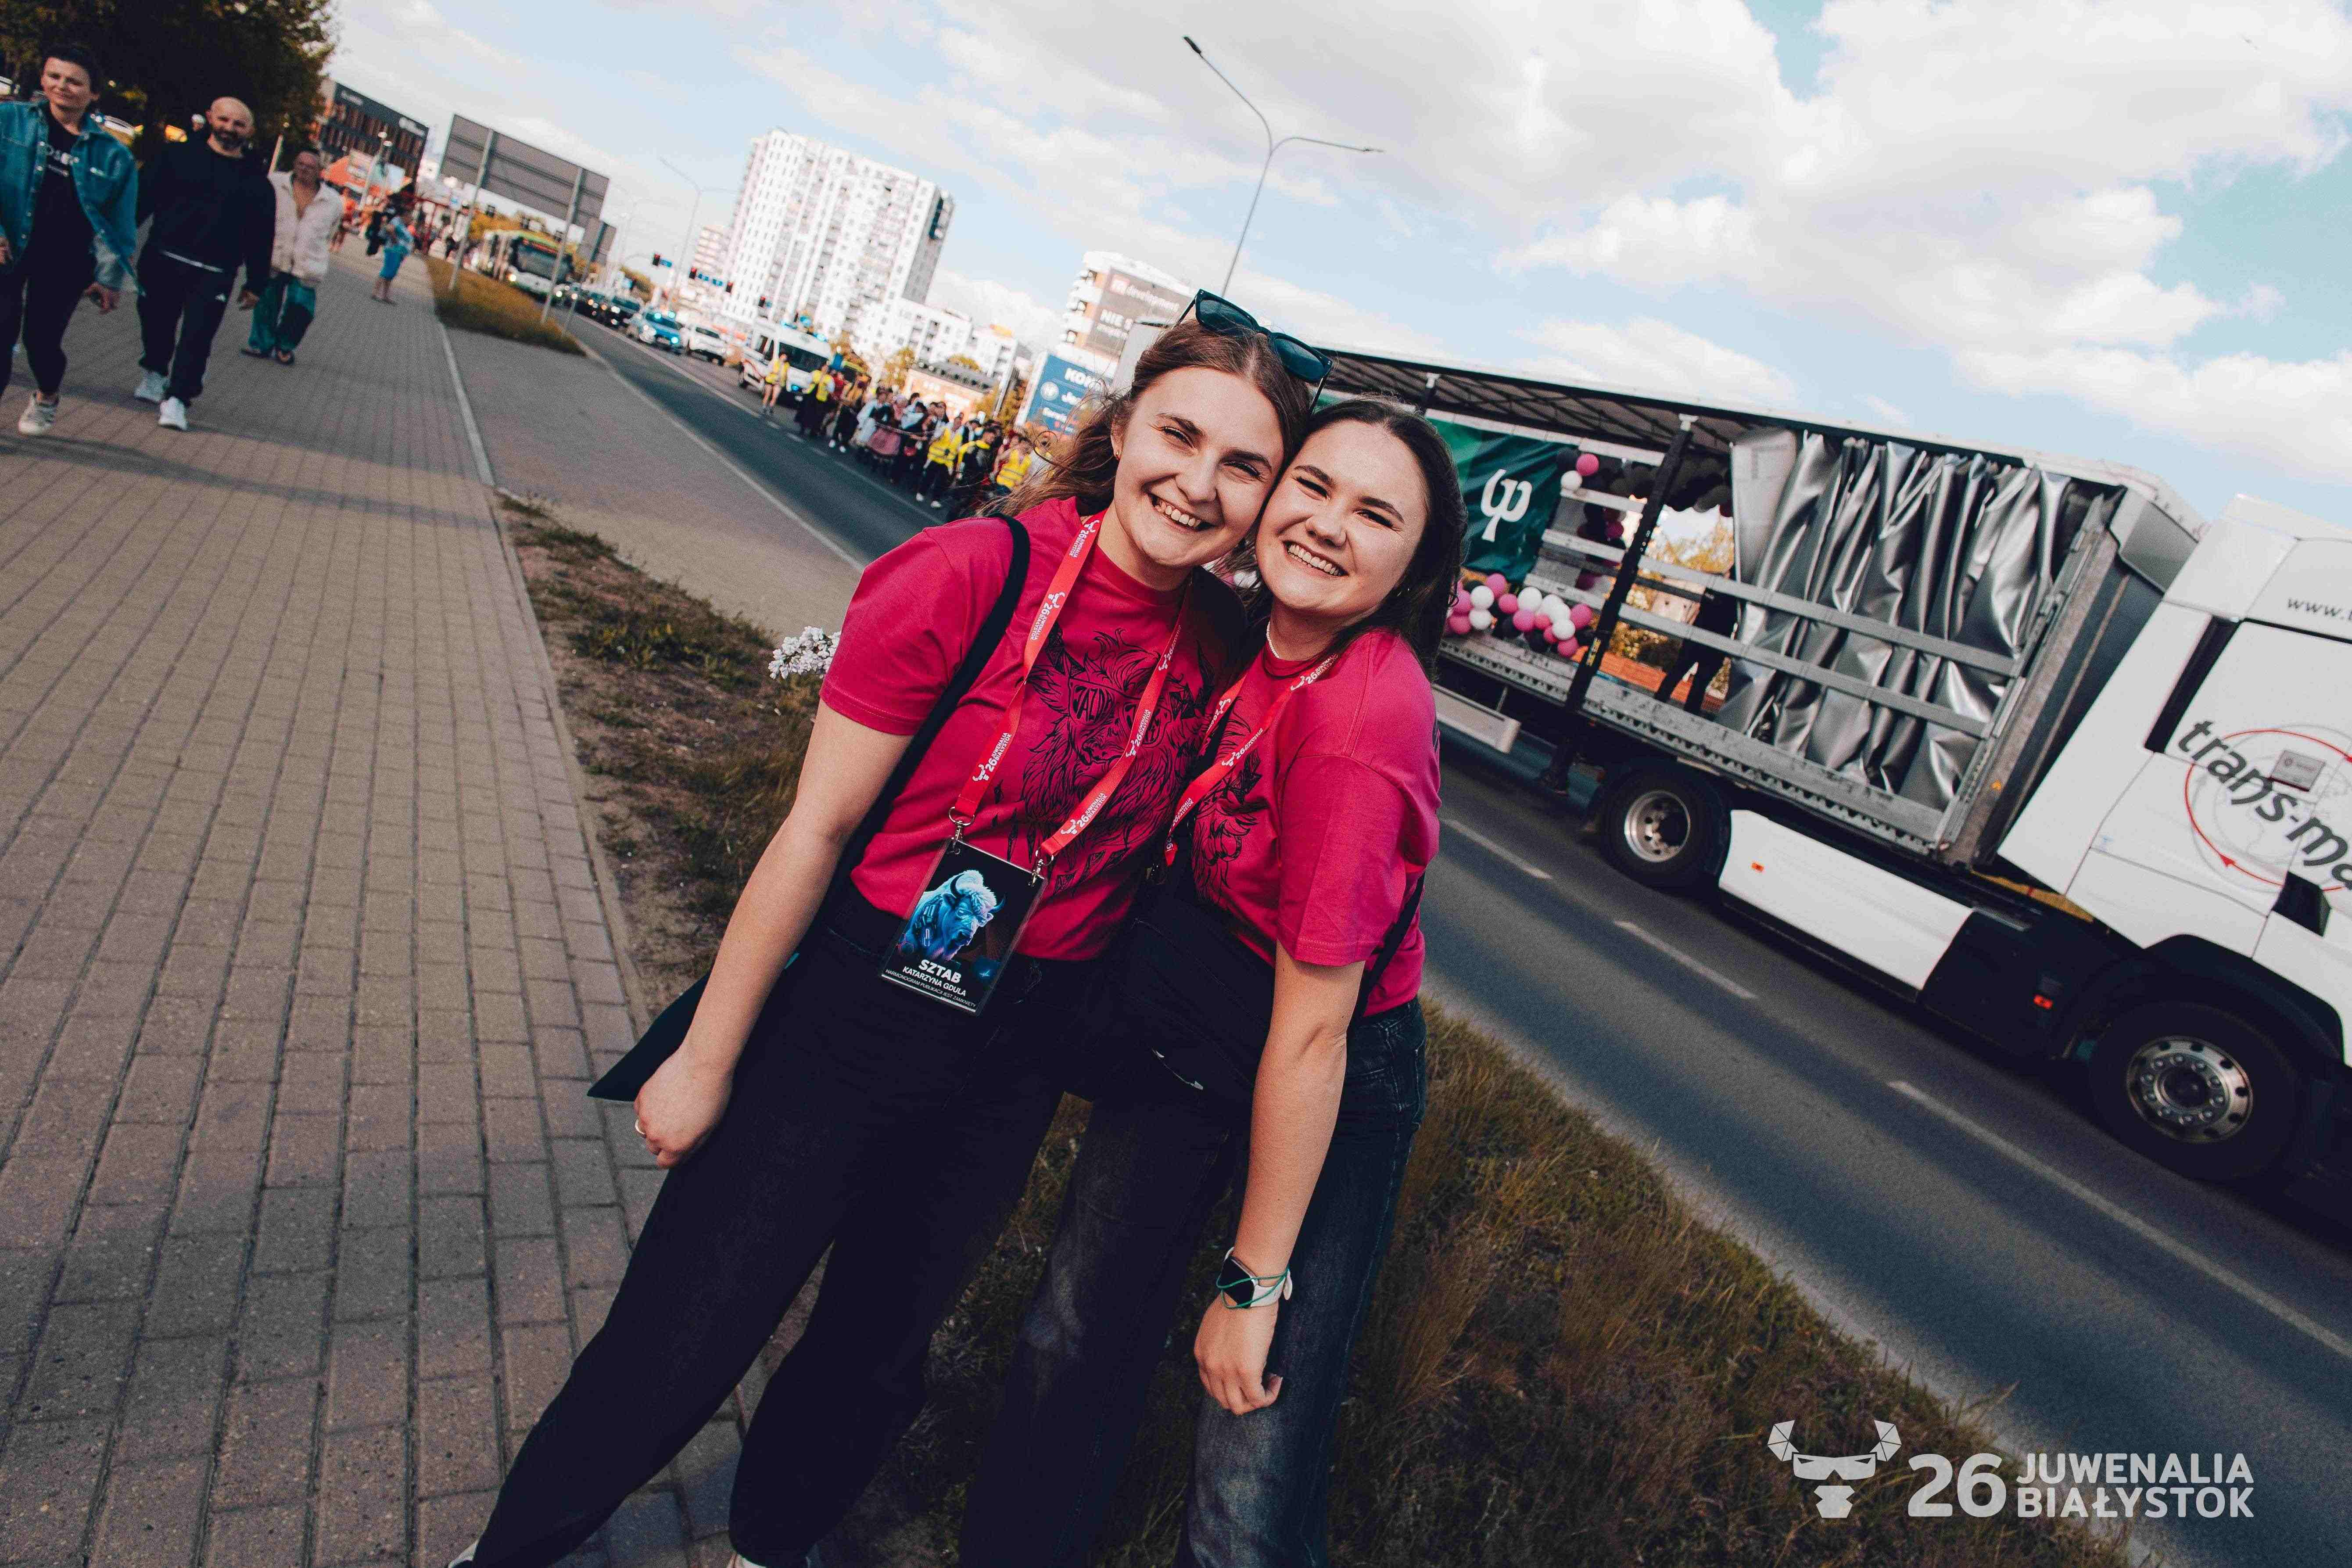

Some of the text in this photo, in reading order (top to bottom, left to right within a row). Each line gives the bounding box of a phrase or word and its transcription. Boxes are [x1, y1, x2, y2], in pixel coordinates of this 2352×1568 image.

[1041, 603, 1053, 615] 26
[1305, 672, 1318, 684] 26
[991, 732, 1008, 759] JUWENALIA
[995, 733, 1012, 761] BIAŁYSTOK
[1134, 733, 1142, 747] 26
[1235, 747, 1245, 760] 26
[985, 758, 997, 772] 26
[1076, 814, 1089, 828] 26
[885, 969, 920, 986] HARMONOGRAM
[918, 959, 962, 983] SZTAB
[902, 966, 966, 997] KATARZYNA GDULA
